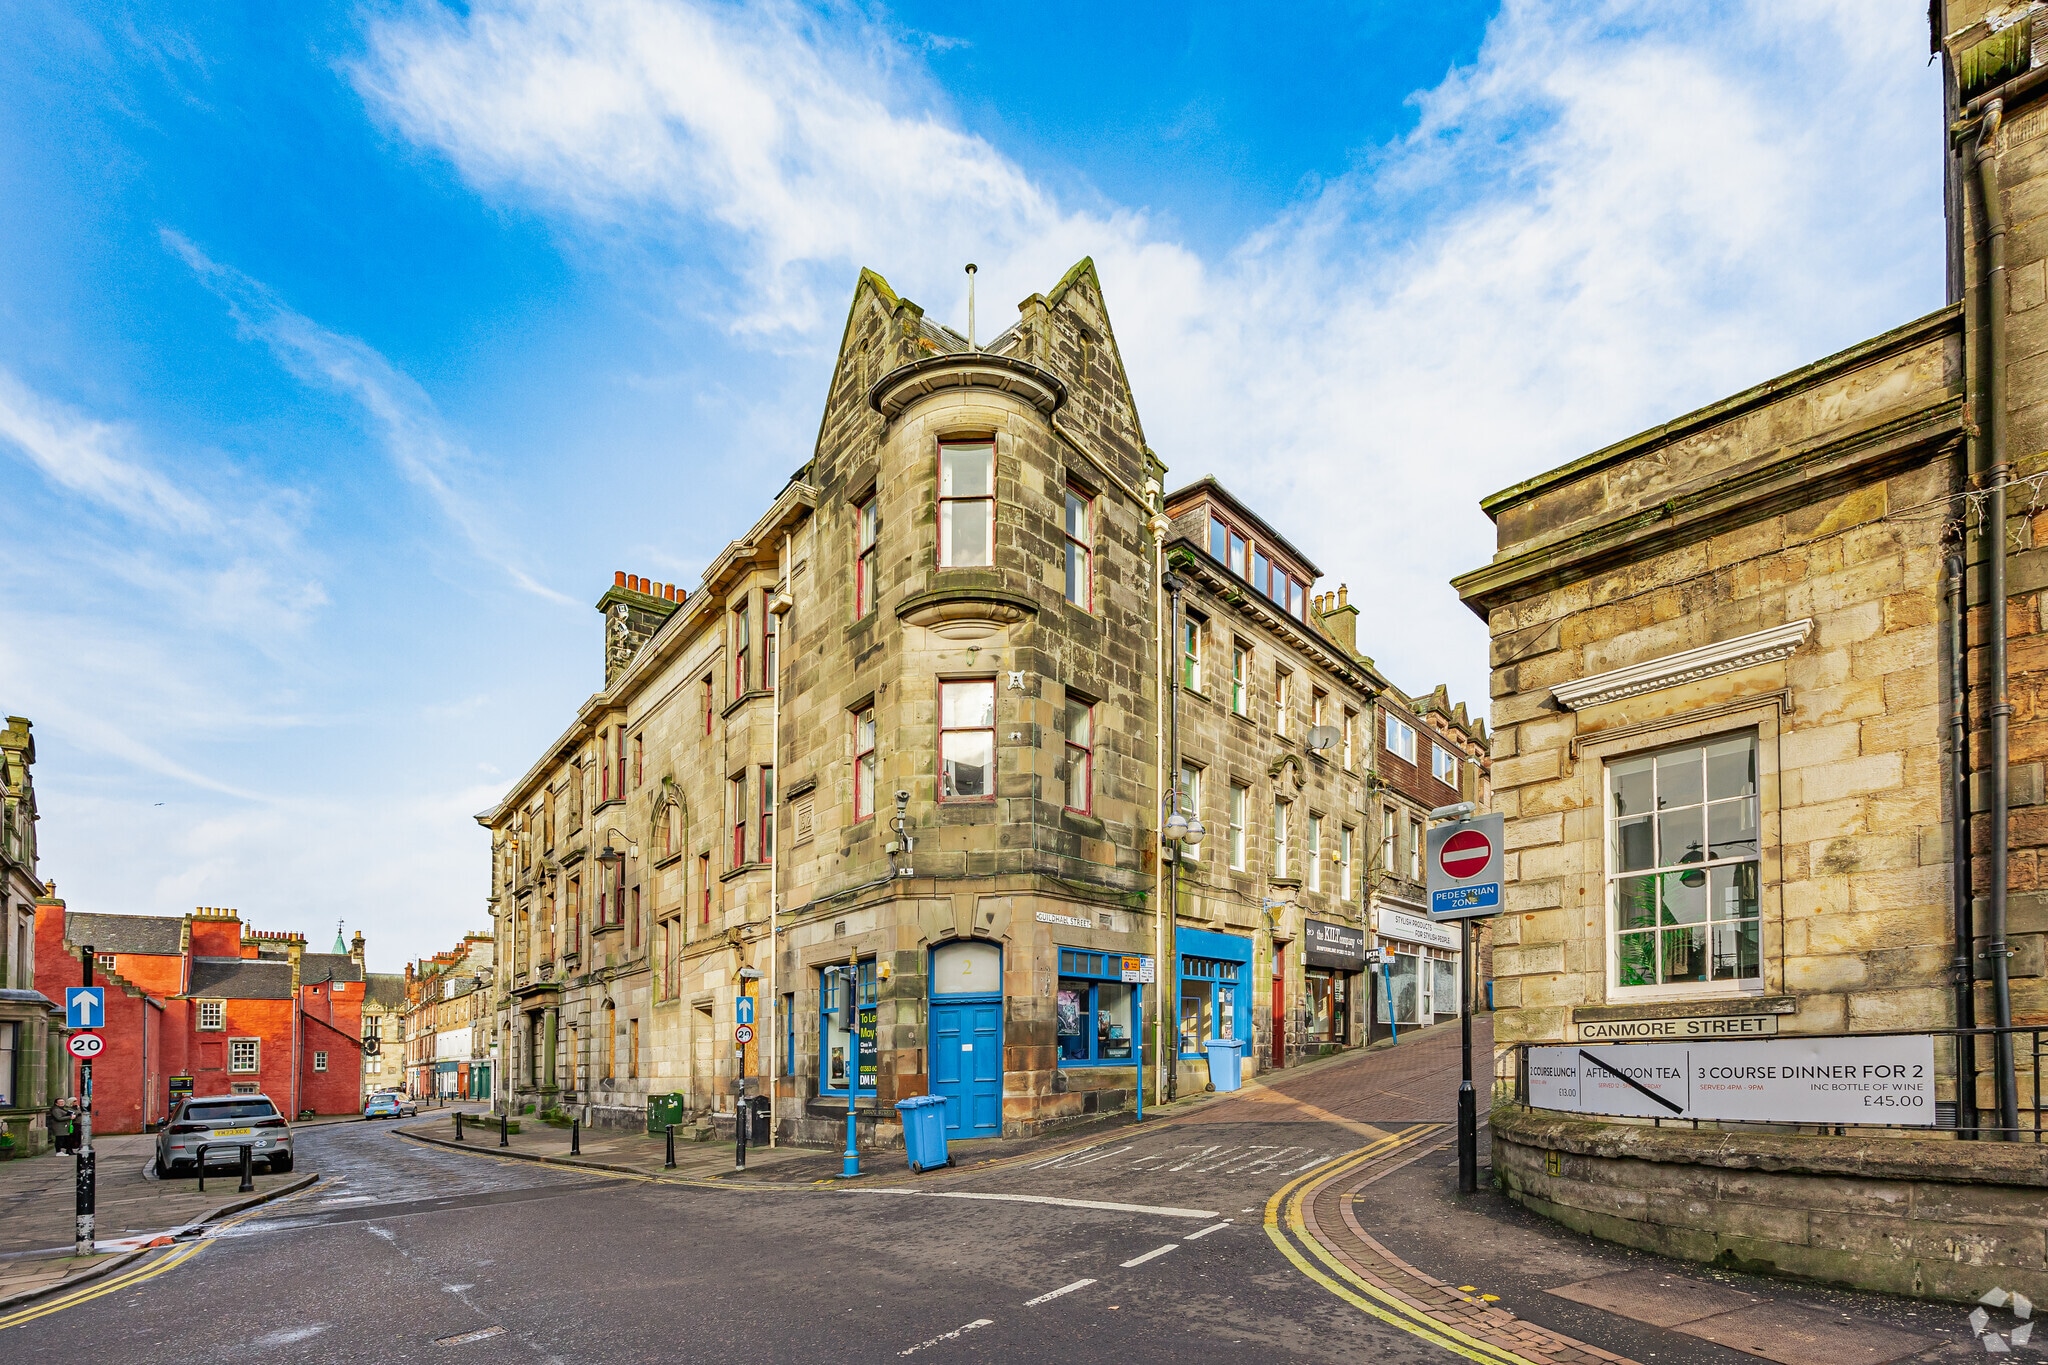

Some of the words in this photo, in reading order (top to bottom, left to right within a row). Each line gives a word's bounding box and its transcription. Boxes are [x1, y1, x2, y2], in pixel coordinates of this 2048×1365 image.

[1436, 886, 1494, 900] PEDESTRIAN
[1452, 898, 1478, 907] ZON
[1070, 917, 1090, 927] STREET
[1395, 916, 1411, 925] STYLISH
[1412, 920, 1432, 931] PRODUCTS
[1324, 926, 1340, 943] KILT
[1366, 951, 1379, 960] KIL
[962, 959, 972, 975] 2
[860, 1013, 868, 1023] To
[869, 1012, 877, 1023] Le
[1583, 1022, 1676, 1037] CANMORE
[1687, 1018, 1767, 1034] STREET
[738, 1030, 751, 1038] 20
[860, 1028, 875, 1040] May
[73, 1039, 101, 1051] 20
[1530, 1067, 1533, 1076] 2
[1533, 1067, 1553, 1076] COURSE
[1554, 1067, 1576, 1077] LUNCH
[1656, 1067, 1681, 1079] TEA
[1698, 1067, 1705, 1079] 3
[1710, 1066, 1776, 1079] COURSE
[1782, 1065, 1857, 1079] DINNER
[1863, 1065, 1906, 1078] FOR
[1912, 1065, 1923, 1078] 2
[860, 1075, 870, 1085] DM
[1559, 1088, 1576, 1097] £13.00
[1810, 1083, 1829, 1091] INC
[1832, 1083, 1870, 1091] BOTTLE
[1872, 1083, 1889, 1091] OF
[1891, 1083, 1923, 1091] WINE
[1863, 1095, 1924, 1107] £45.00
